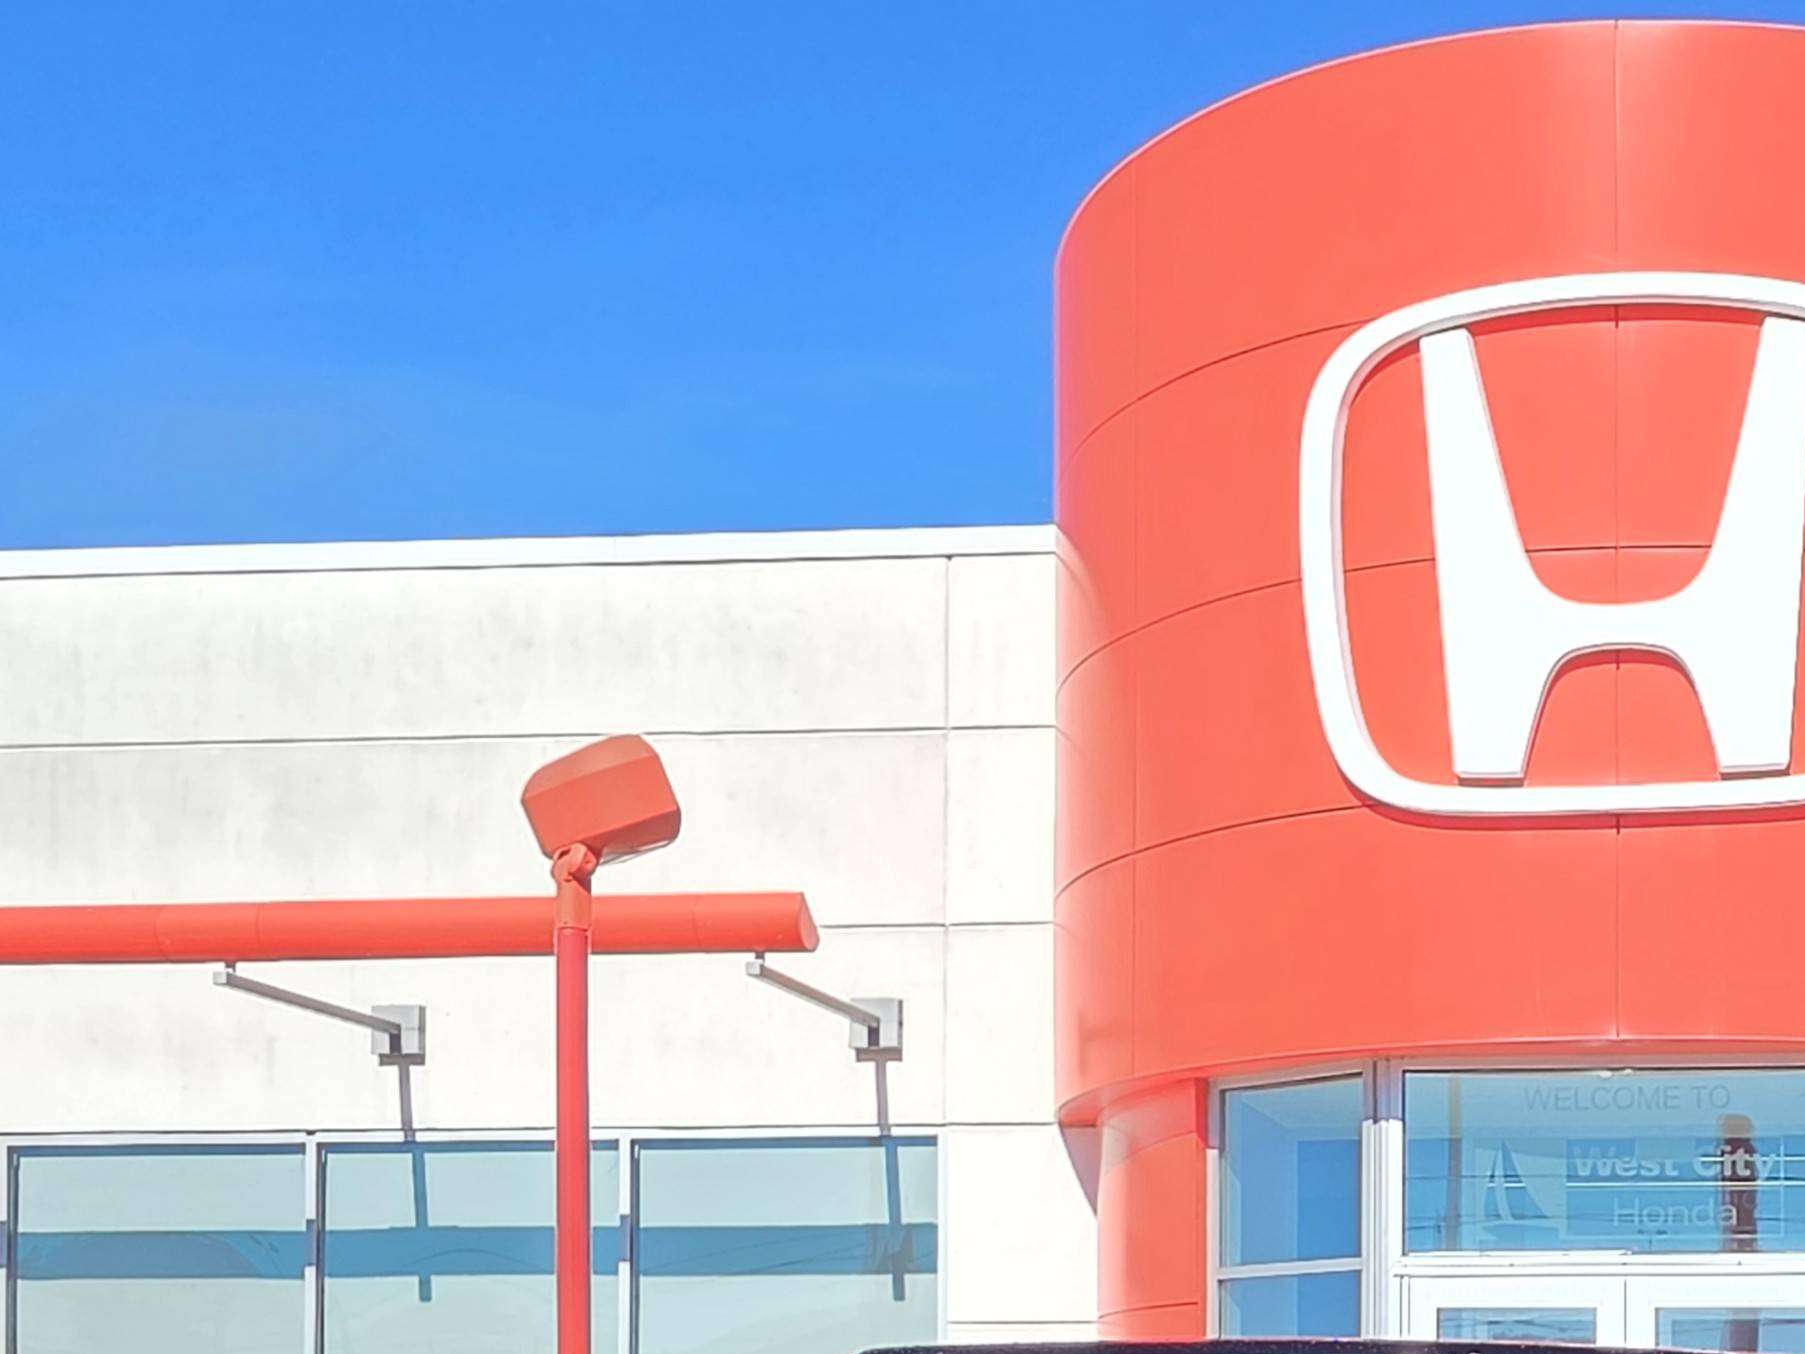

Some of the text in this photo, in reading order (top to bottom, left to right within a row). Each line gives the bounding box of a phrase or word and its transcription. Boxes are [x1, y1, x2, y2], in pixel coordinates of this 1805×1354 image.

[1523, 1083, 1731, 1111] WELCOME TO
[1573, 1145, 1778, 1184] West City
[1613, 1197, 1739, 1228] Honda
